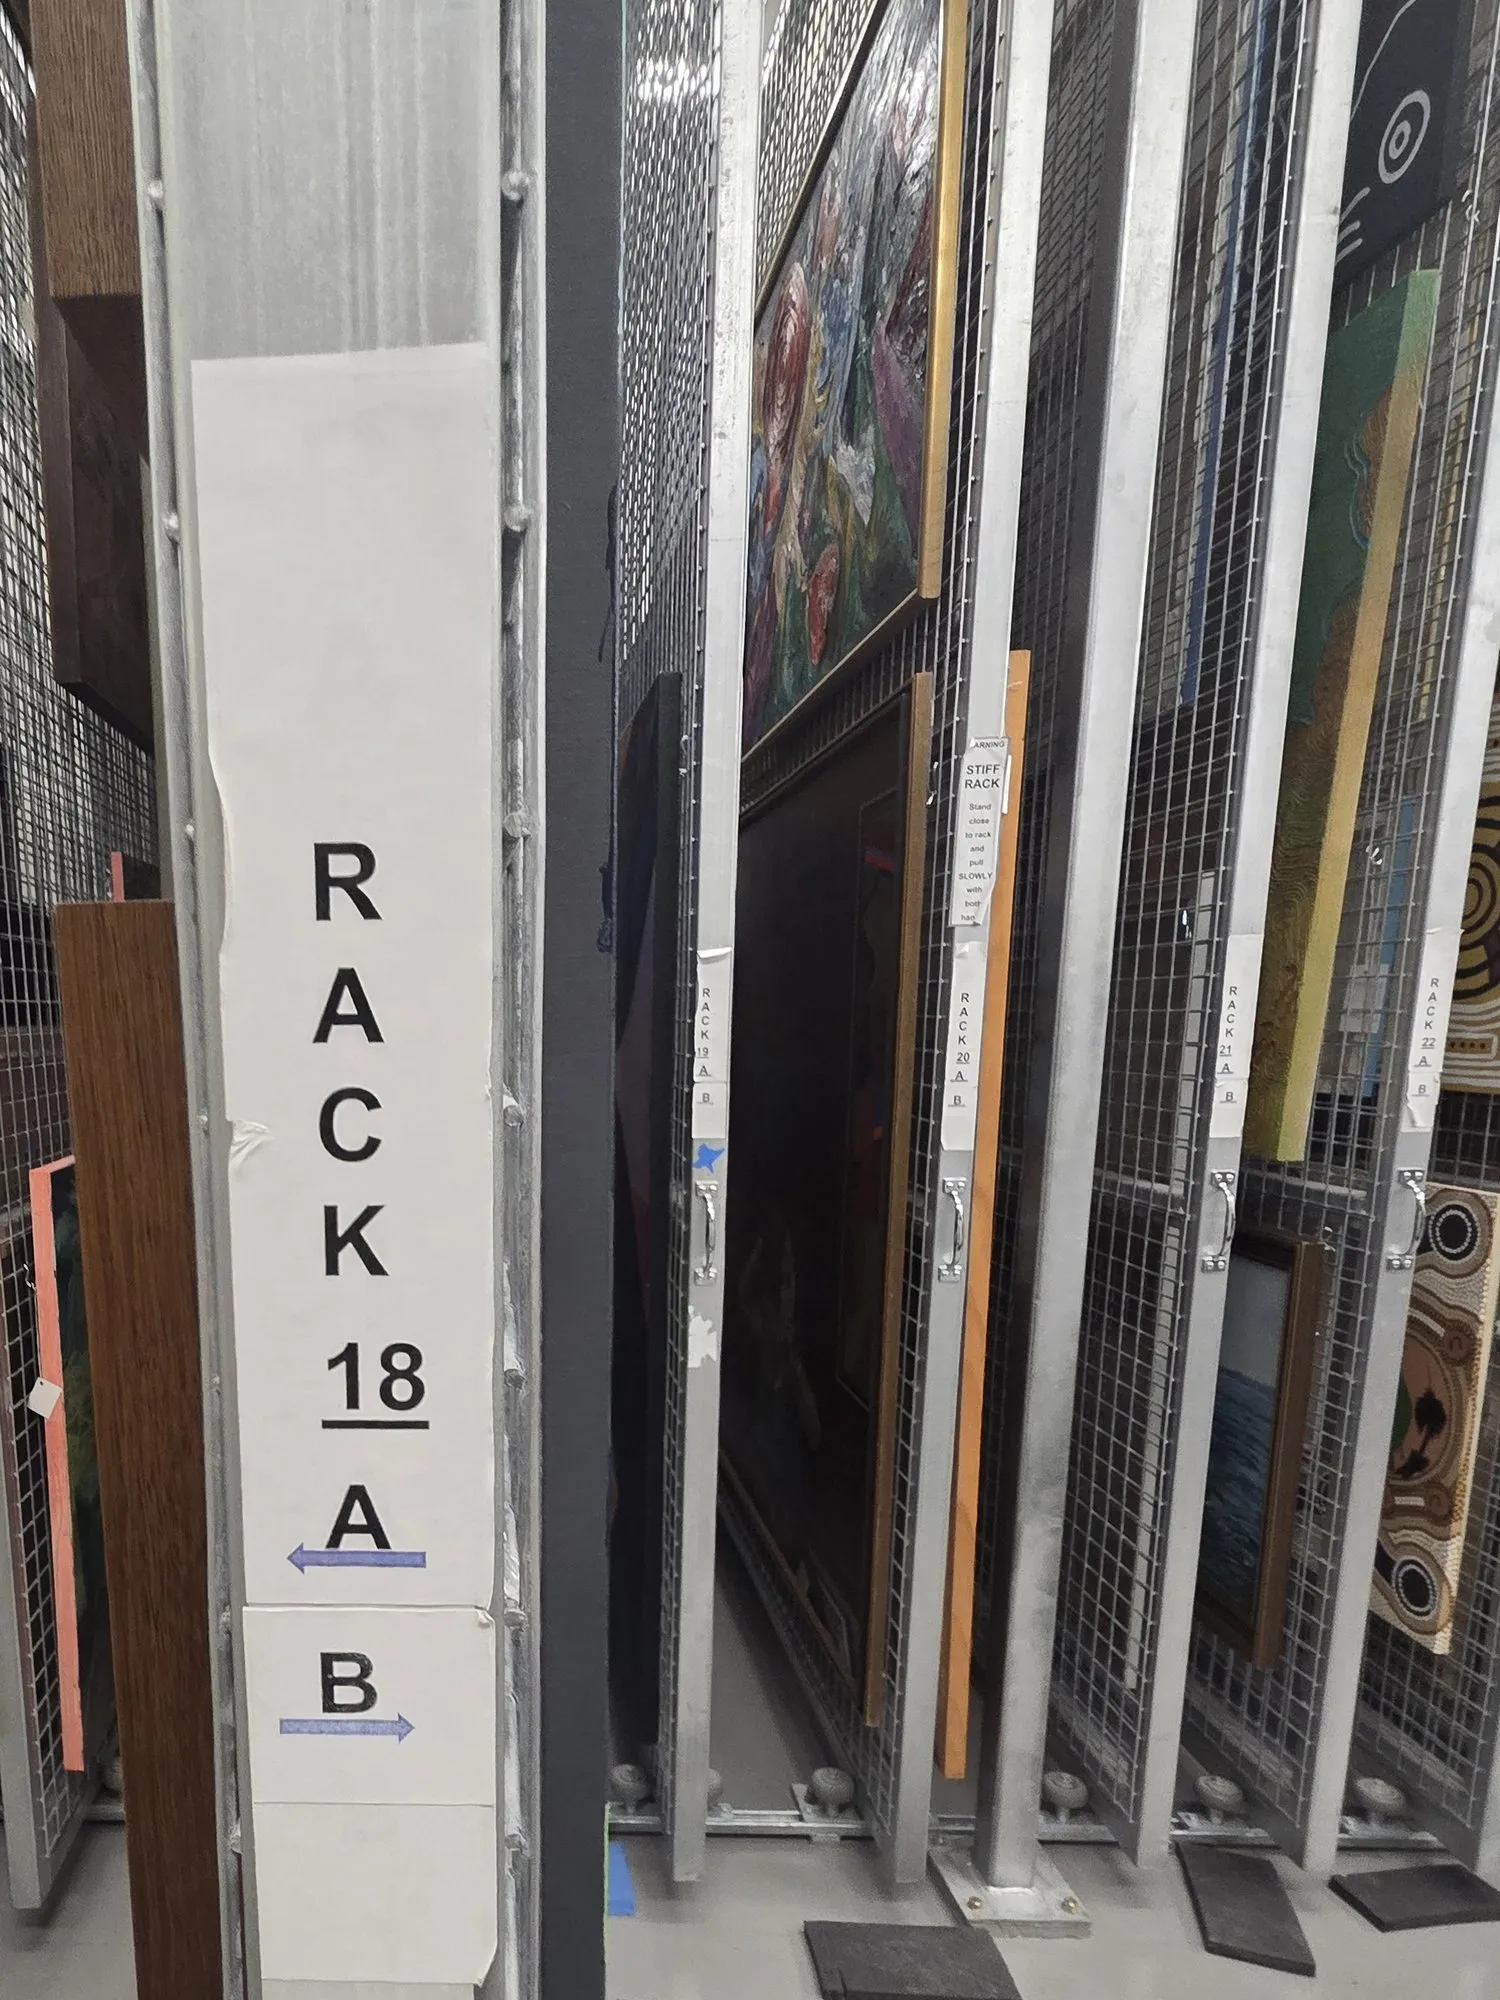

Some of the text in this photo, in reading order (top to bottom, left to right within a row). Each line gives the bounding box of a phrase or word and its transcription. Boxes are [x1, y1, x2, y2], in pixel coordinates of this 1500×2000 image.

[974, 740, 1005, 748] ARNING
[966, 764, 1000, 775] STIFF
[964, 778, 1000, 789] RACK
[969, 803, 992, 811] Stand
[969, 859, 983, 867] pull
[958, 872, 993, 880] SLOWLY
[1423, 977, 1440, 1030] RACK
[700, 987, 711, 1040] RACK
[1225, 985, 1238, 1038] RACK
[957, 992, 970, 1046] RACK
[1421, 1037, 1436, 1047] 22
[697, 1046, 709, 1057] 19
[1219, 1044, 1232, 1055] 21
[312, 841, 391, 1278] RACK
[957, 1051, 970, 1062] 20
[1418, 1055, 1428, 1066] A
[700, 1064, 709, 1075] A
[1221, 1062, 1231, 1073] A
[954, 1070, 965, 1080] A
[1418, 1083, 1426, 1094] B
[702, 1092, 711, 1103] B
[953, 1095, 962, 1105] B
[1225, 1091, 1234, 1102] B
[327, 1341, 426, 1411] 18
[325, 1484, 392, 1550] A
[319, 1651, 378, 1714] B
